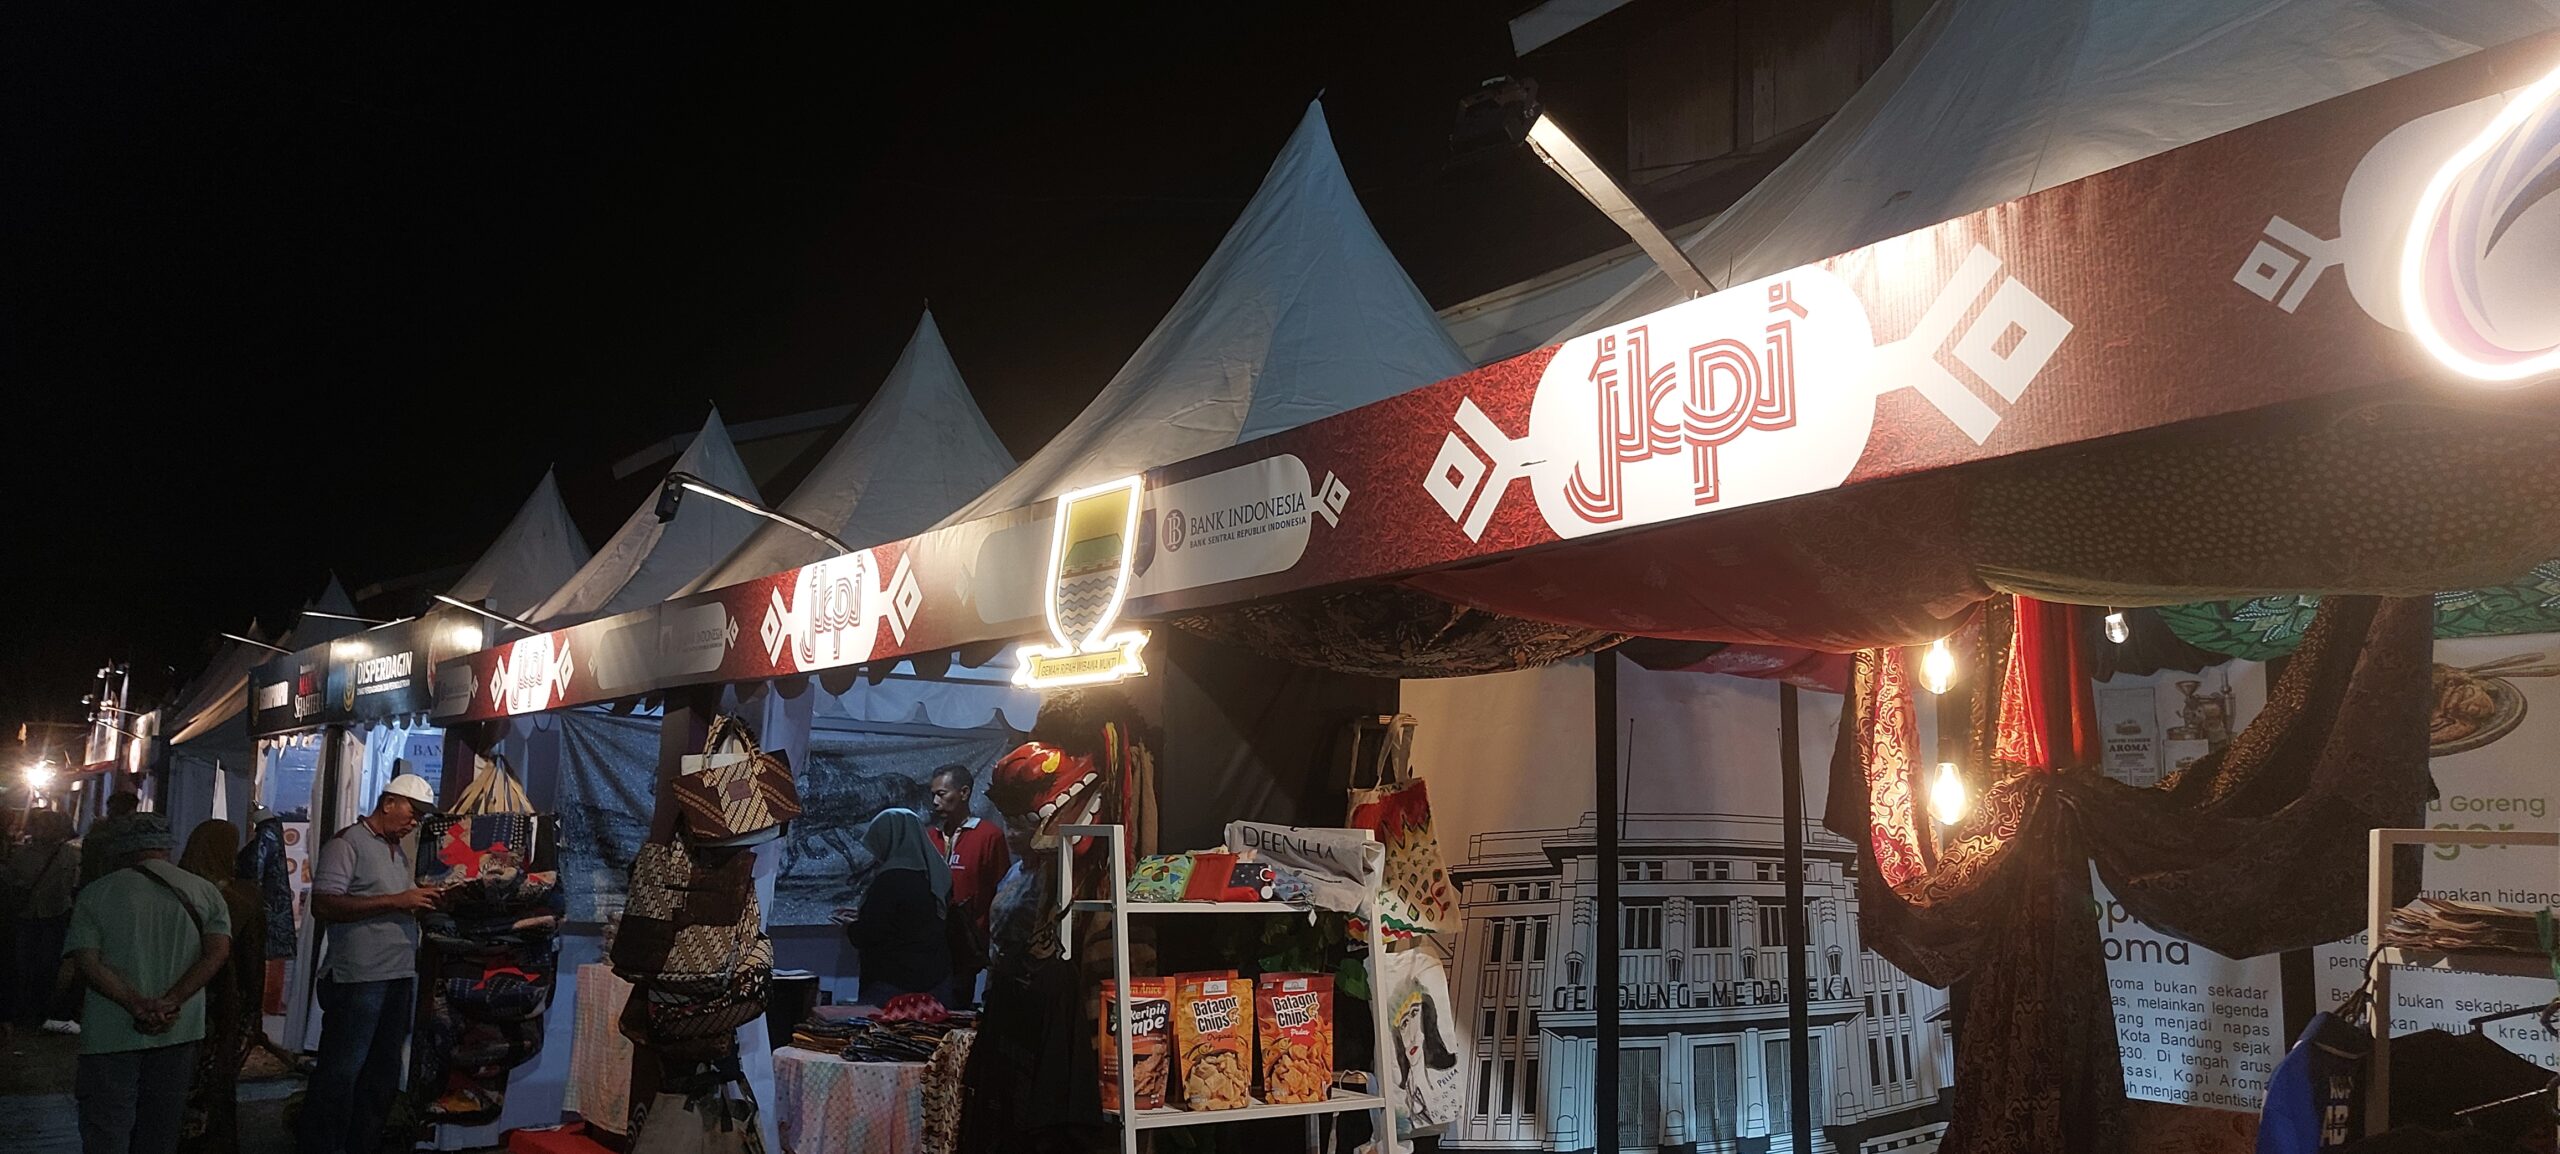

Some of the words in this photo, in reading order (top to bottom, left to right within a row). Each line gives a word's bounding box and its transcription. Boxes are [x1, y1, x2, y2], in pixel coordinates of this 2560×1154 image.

[1190, 510, 1226, 536] BANK
[1229, 492, 1306, 527] INDONESIA
[1189, 537, 1208, 549] BANK
[1208, 533, 1235, 546] SENTRAL
[1237, 526, 1266, 540] REPUBLIK
[1268, 516, 1307, 532] INDONESIA
[357, 651, 413, 686] DISPERDAGIN
[2450, 795, 2546, 818] Goreng
[2154, 979, 2197, 995] bukan
[2208, 984, 2269, 1000] sekadar
[1193, 996, 1237, 1017] Batagor
[1273, 992, 1317, 1012] Batagor
[2137, 997, 2205, 1013] melainkan
[2212, 1001, 2269, 1018] legenda
[2397, 993, 2444, 1009] bukan
[1197, 1013, 1230, 1033] Chips
[1277, 1009, 1309, 1028] Chips
[2154, 1016, 2212, 1032] menjadi
[2223, 1022, 2270, 1037] napas
[2120, 1028, 2150, 1043] Kota
[2161, 1032, 2222, 1052] Bandung
[2233, 1042, 2271, 1056] sejak
[2157, 1049, 2171, 1062] Di
[2181, 1053, 2229, 1069] tengah
[2240, 1060, 2272, 1073] arus
[2174, 1069, 2209, 1086] Kopi
[2142, 1084, 2198, 1103] menjaga
